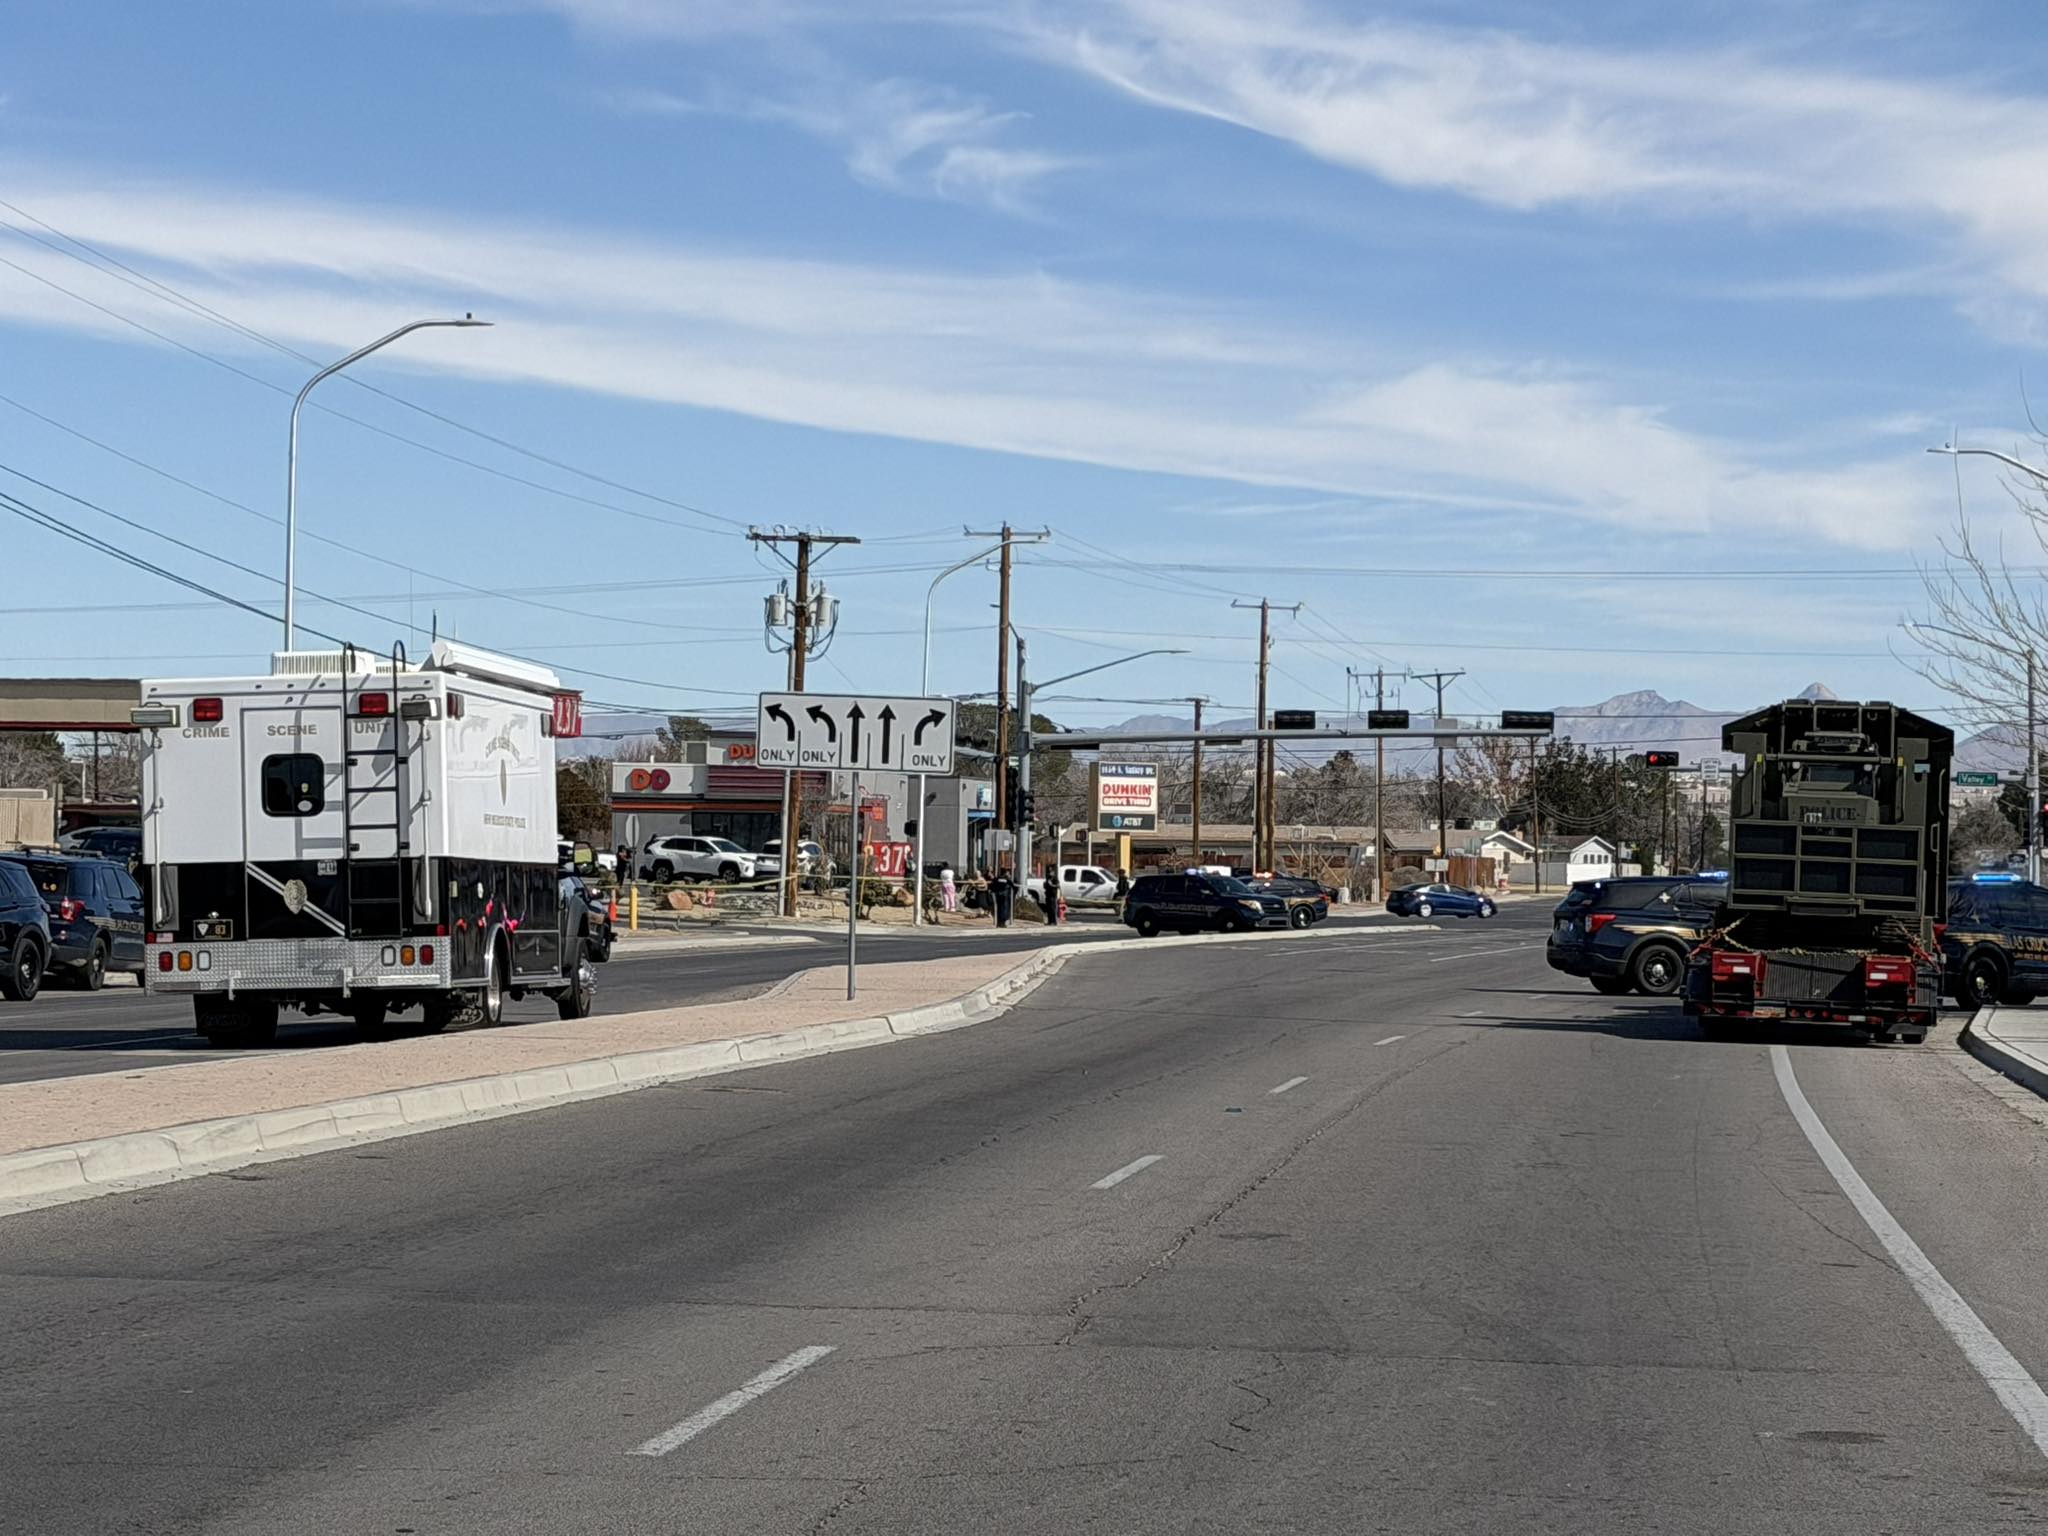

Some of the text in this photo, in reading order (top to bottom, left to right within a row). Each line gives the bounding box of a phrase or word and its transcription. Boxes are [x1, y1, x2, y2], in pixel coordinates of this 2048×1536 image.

[182, 721, 390, 738] CRIME SCENE UNIT
[761, 748, 795, 762] ONLY
[802, 750, 836, 763] ONLY
[912, 754, 946, 767] ONLY
[1961, 774, 1985, 785] Valley
[1104, 797, 1127, 806] DRIVE
[1123, 817, 1143, 827] AT&T
